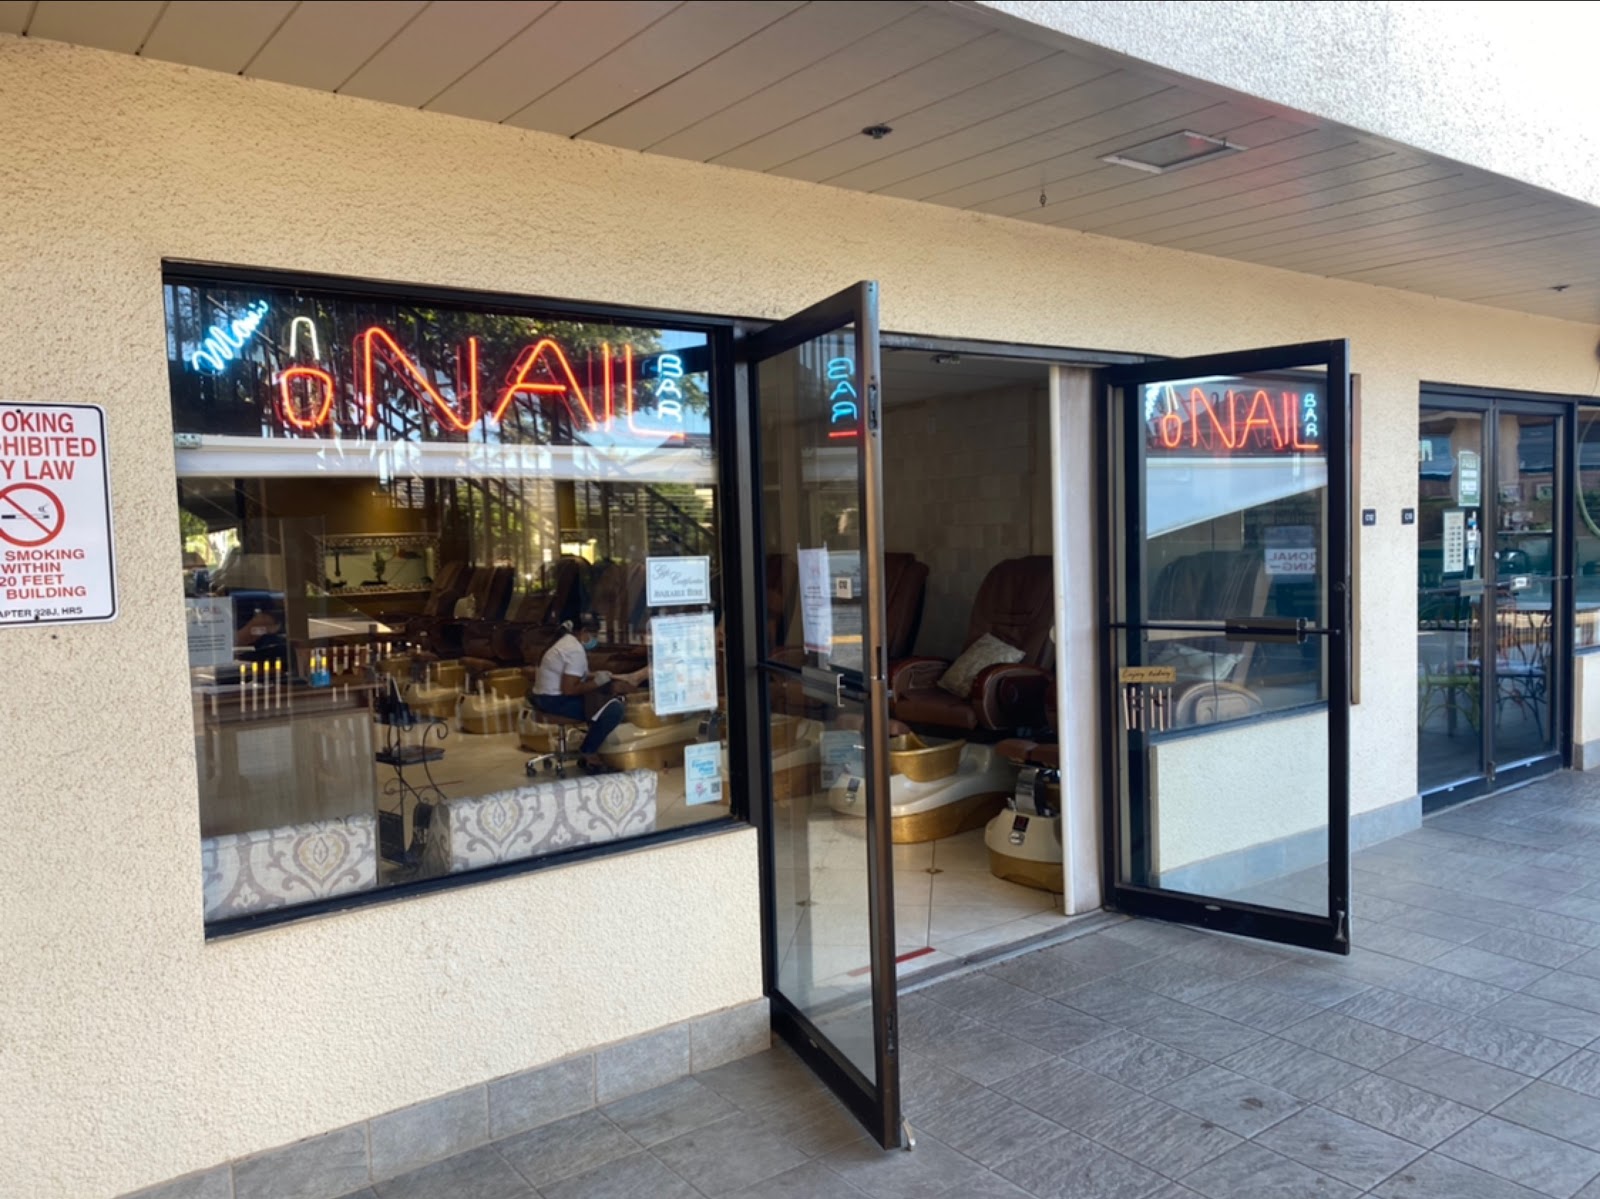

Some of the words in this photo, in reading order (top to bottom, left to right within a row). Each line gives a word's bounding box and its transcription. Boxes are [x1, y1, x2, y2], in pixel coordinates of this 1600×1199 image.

[362, 325, 687, 441] NAIL
[655, 353, 684, 423] BAR
[1190, 387, 1319, 449] NAIL
[1304, 393, 1319, 438] BAR
[0, 436, 97, 457] HIBITED
[24, 460, 75, 480] LAW
[5, 548, 85, 562] SMOKING
[1, 562, 61, 574] WITHIN
[0, 576, 17, 587] 20
[22, 574, 65, 586] FEET
[6, 586, 87, 600] BUILDING
[61, 606, 83, 615] HRS
